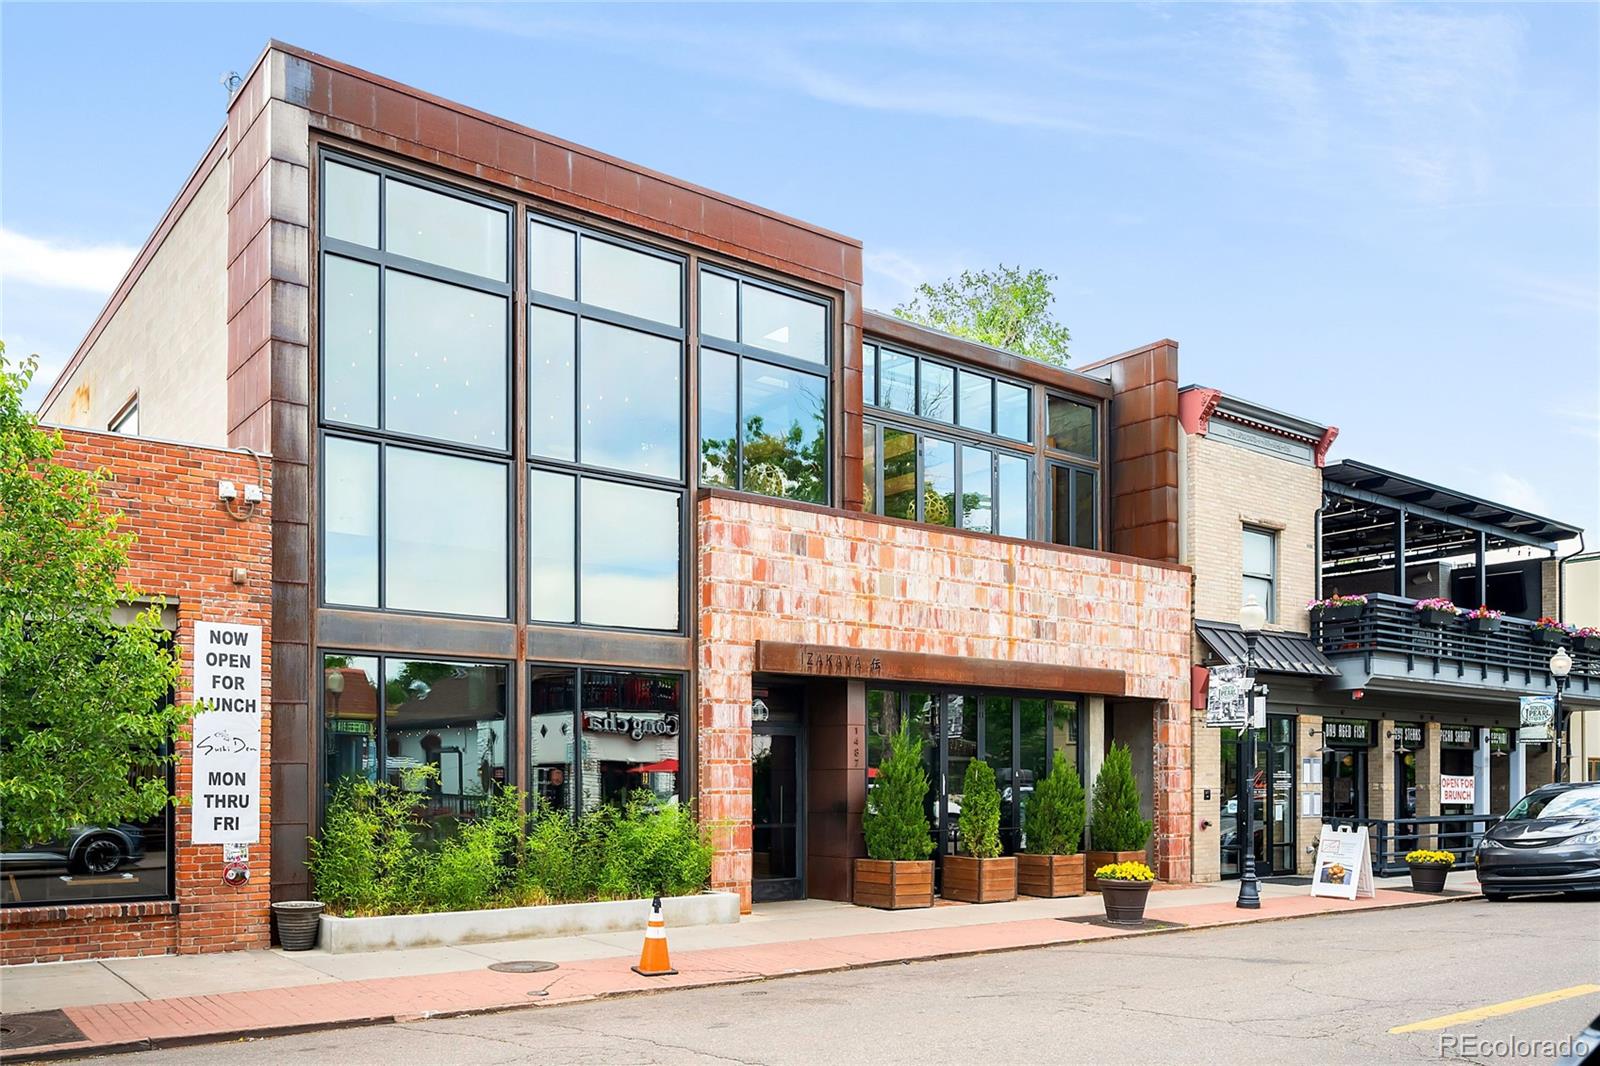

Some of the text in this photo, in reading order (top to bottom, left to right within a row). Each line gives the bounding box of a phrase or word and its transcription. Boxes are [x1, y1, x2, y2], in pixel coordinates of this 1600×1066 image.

[209, 630, 248, 646] NOW
[206, 652, 250, 668] OPEN
[801, 652, 862, 668] IZAKAYA
[212, 675, 245, 690] FOR
[1404, 728, 1421, 741] STEAKS
[197, 735, 230, 755] Sushi
[233, 737, 257, 753] Den
[208, 771, 246, 786] MON
[1442, 778, 1473, 788] OPEN FOR
[204, 794, 249, 808] THRU
[1444, 790, 1472, 800] BRUNCH
[214, 816, 239, 831] FRI
